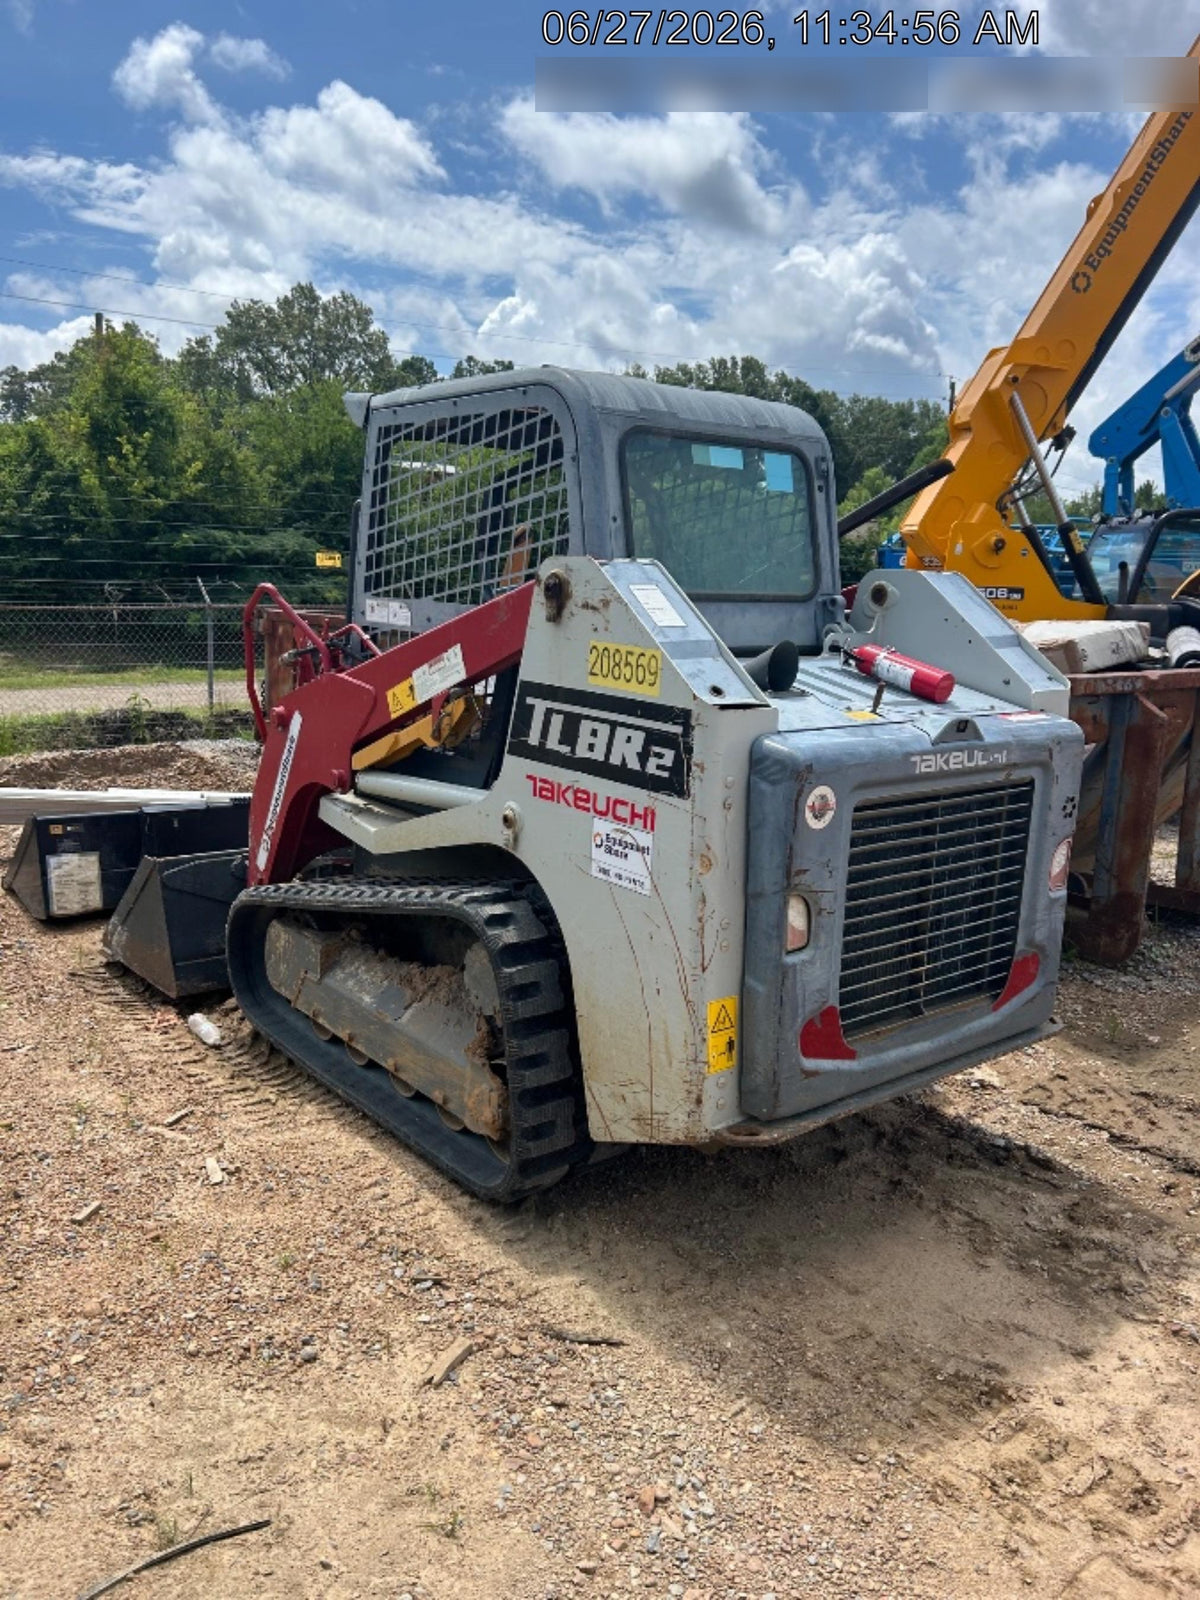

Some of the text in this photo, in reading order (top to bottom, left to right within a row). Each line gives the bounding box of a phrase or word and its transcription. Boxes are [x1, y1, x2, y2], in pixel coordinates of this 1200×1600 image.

[1084, 111, 1194, 273] EquipmentShare
[588, 643, 660, 688] 208569
[525, 773, 656, 833] TAKEUCHI
